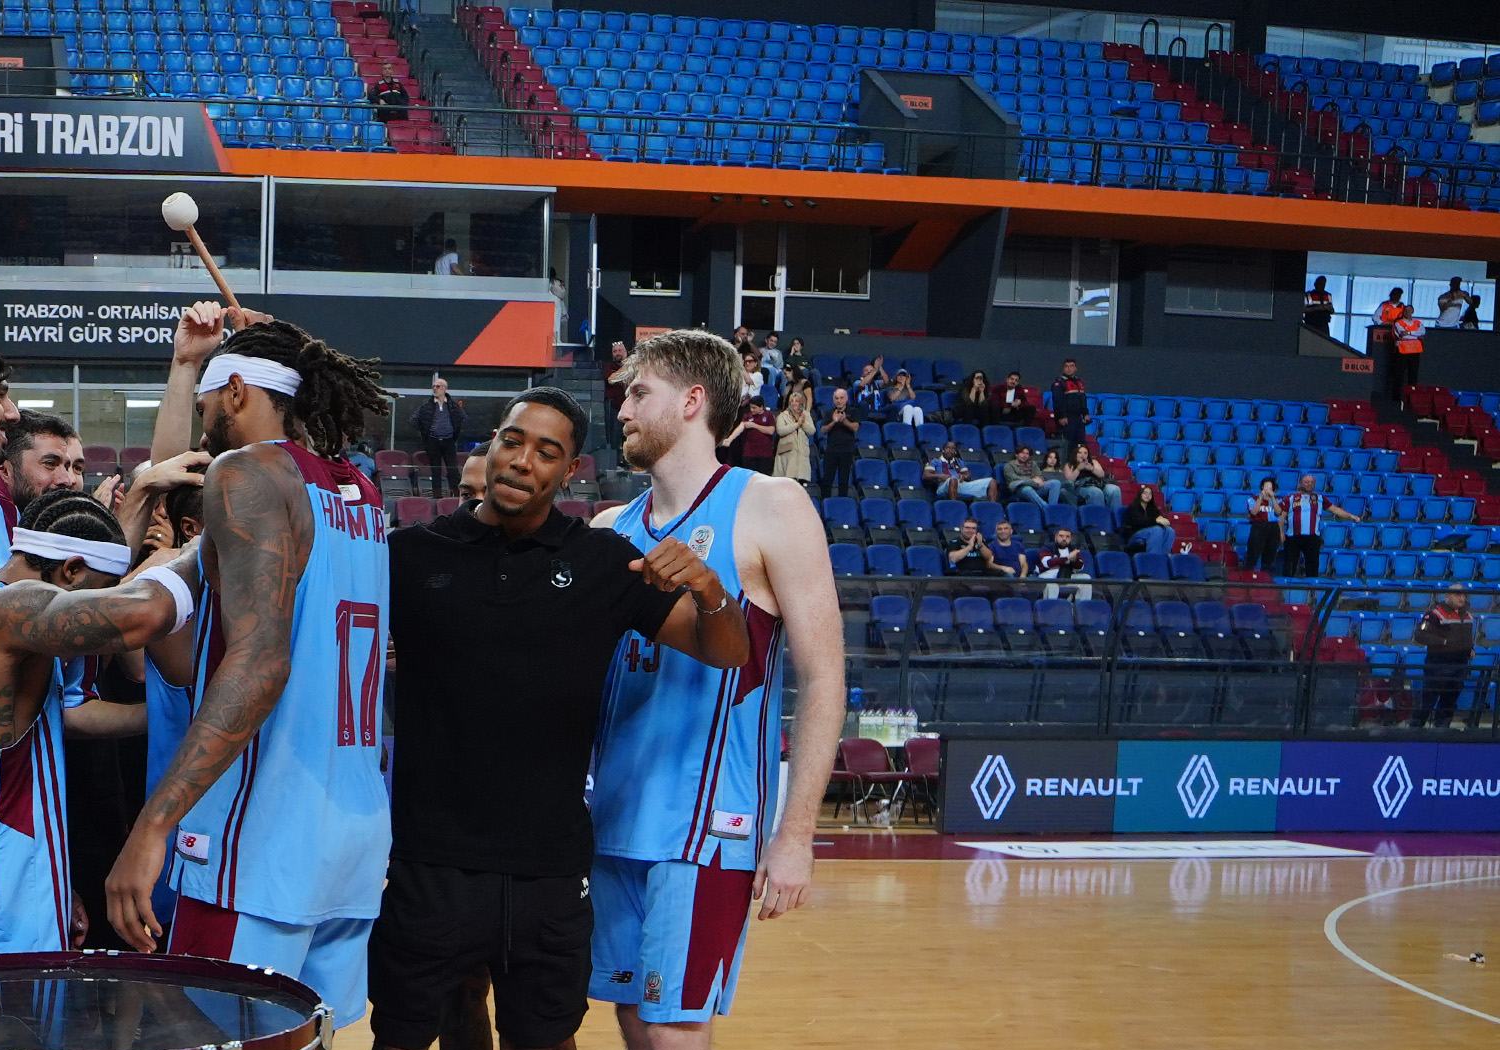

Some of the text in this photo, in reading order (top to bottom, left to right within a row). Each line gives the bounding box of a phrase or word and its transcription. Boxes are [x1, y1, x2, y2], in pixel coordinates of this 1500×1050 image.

[31, 113, 184, 157] TRABZON
[4, 304, 83, 319] TRABZON
[3, 322, 173, 344] HAYRİ GÜR SPOR
[336, 599, 381, 747] 17
[1026, 777, 1143, 797] RENAULT
[1228, 777, 1341, 796] RENAULT
